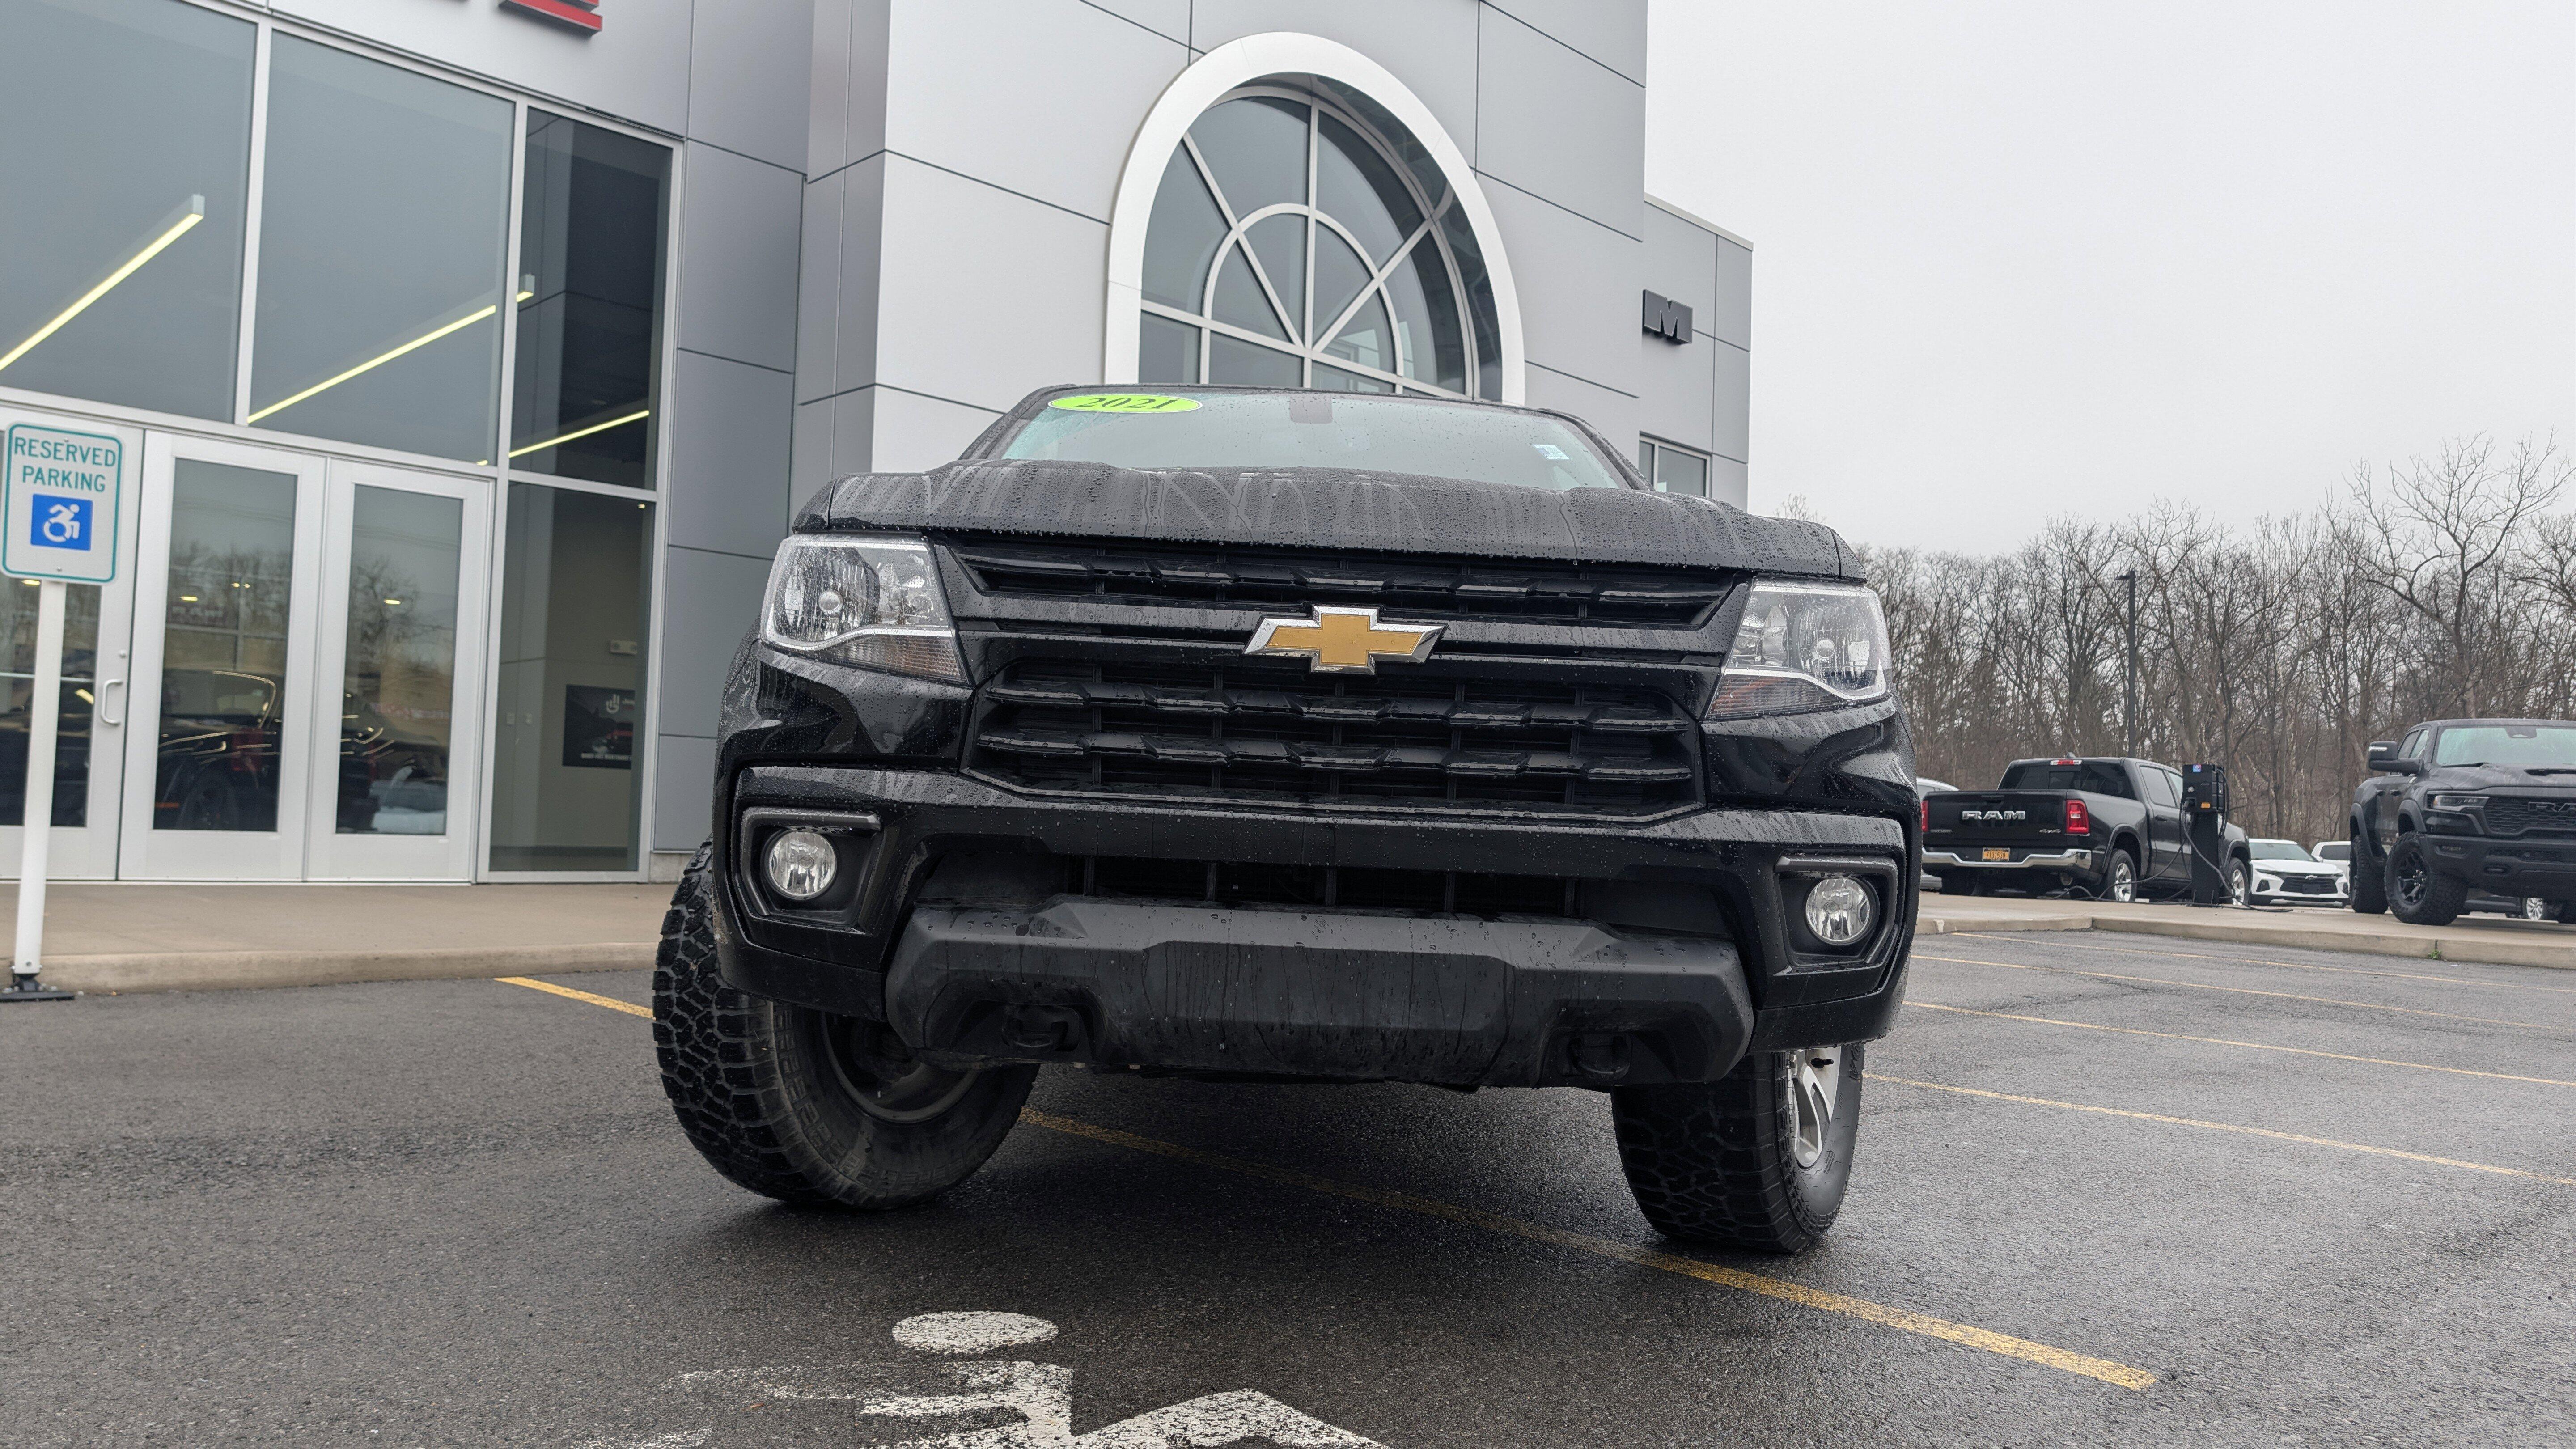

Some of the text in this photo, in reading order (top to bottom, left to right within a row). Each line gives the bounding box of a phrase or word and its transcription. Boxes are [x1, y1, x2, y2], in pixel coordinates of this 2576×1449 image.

[1074, 397, 1178, 409] 2021
[14, 437, 116, 466] RESERVED
[22, 465, 106, 492] PARKING
[1962, 810, 2025, 820] RAM
